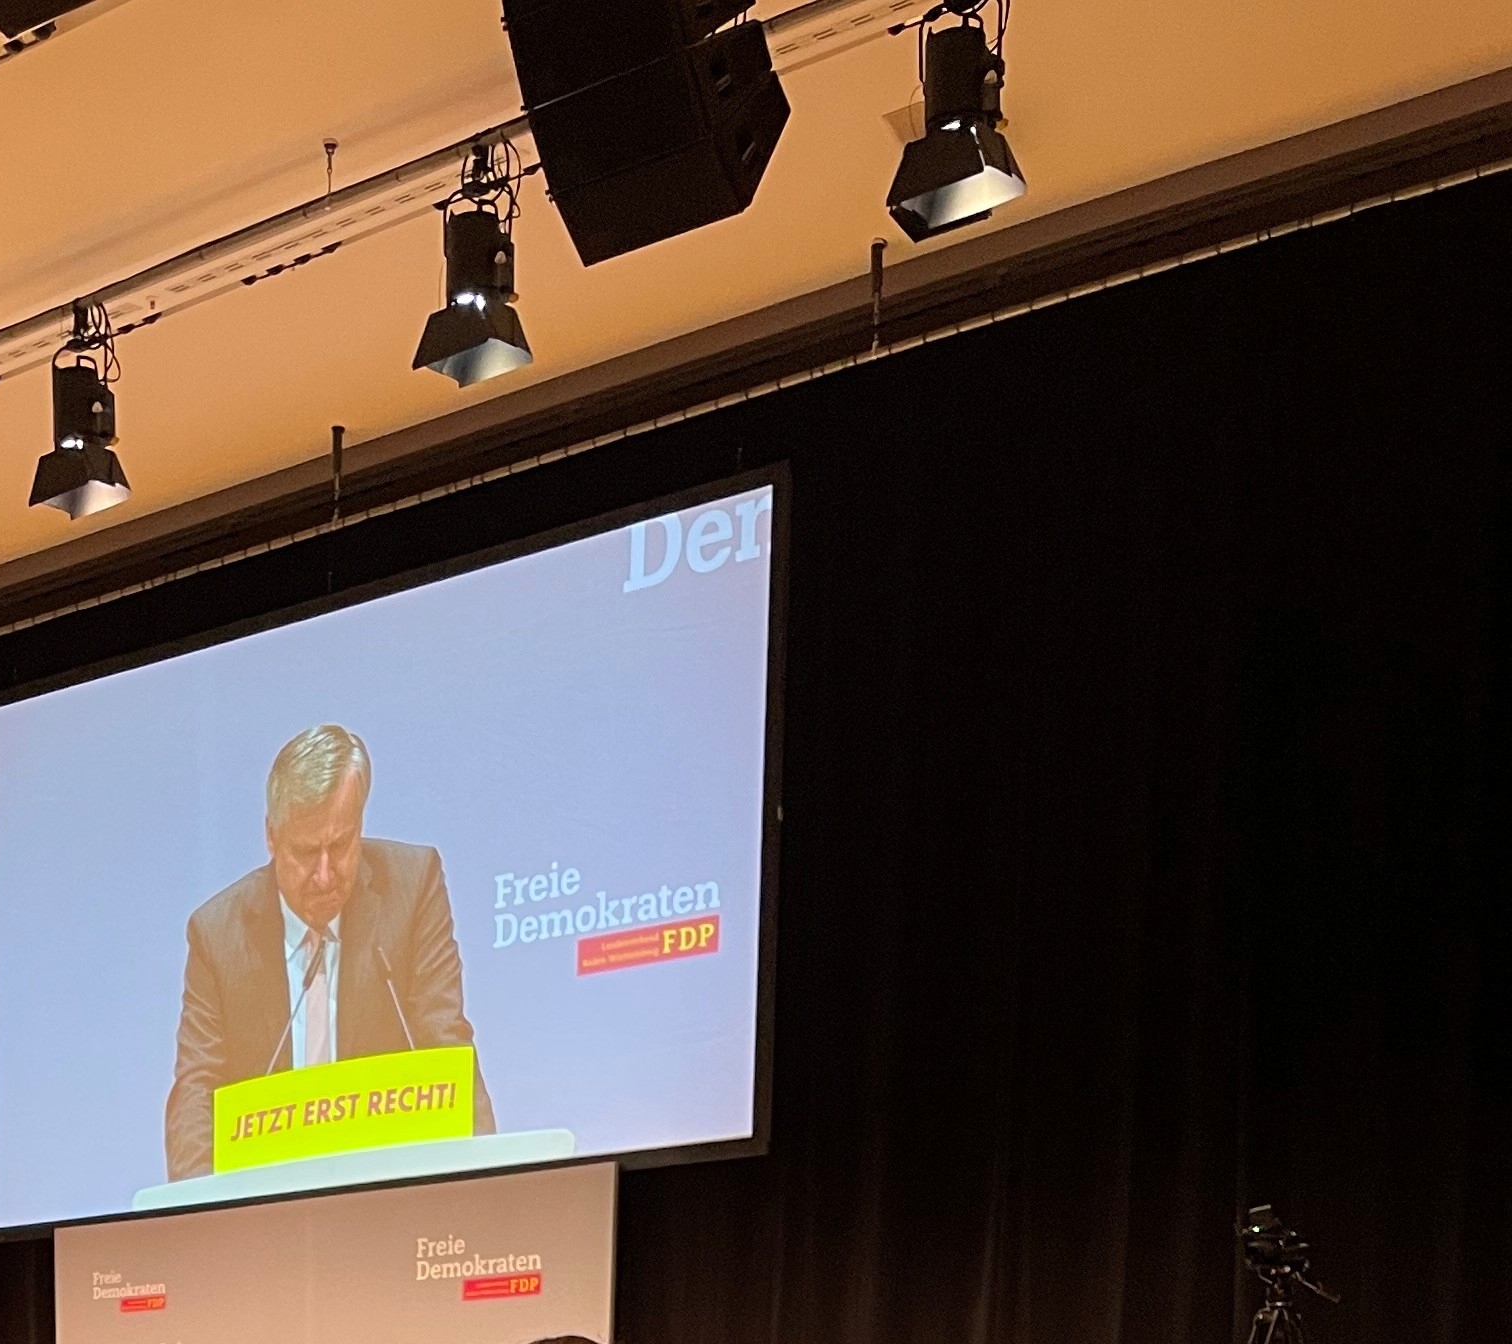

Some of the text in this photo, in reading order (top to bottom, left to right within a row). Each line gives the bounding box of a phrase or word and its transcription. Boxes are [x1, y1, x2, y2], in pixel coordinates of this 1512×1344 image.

[494, 861, 580, 909] Freie
[493, 880, 720, 948] Demokraten
[662, 923, 715, 954] FDP
[230, 1082, 456, 1142] JETZT ERST RECHT!
[416, 1234, 466, 1258] Freie
[92, 1270, 122, 1286] Freie
[415, 1253, 542, 1281] Demokraten
[92, 1283, 166, 1300] Demokraten
[509, 1277, 539, 1294] FDP
